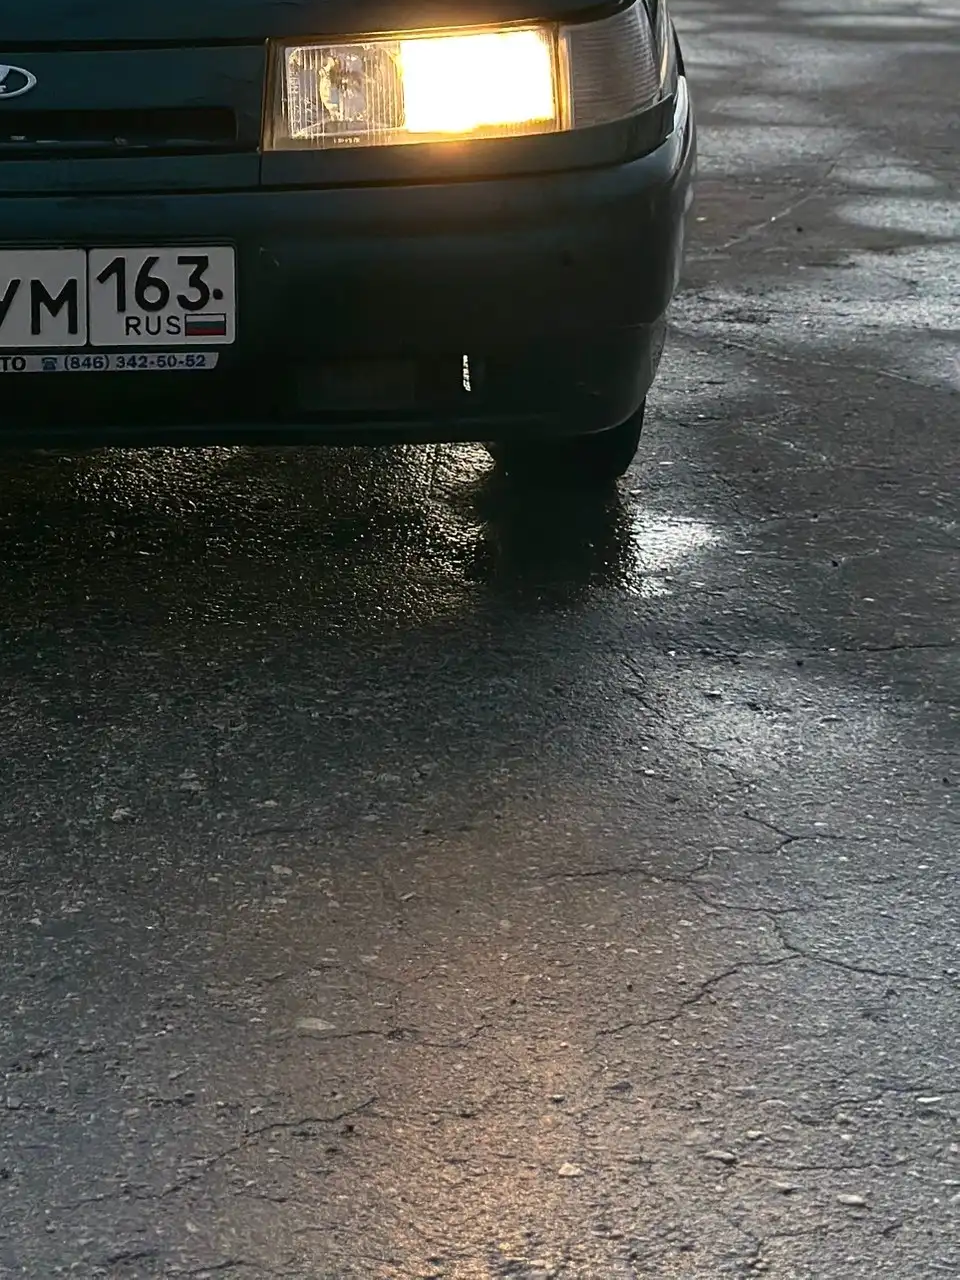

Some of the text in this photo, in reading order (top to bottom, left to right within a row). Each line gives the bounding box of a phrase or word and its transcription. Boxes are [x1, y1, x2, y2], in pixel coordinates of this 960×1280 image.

[96, 255, 210, 312] 163
[125, 316, 181, 336] RUS
[63, 353, 207, 371] (846) 342-50-52
